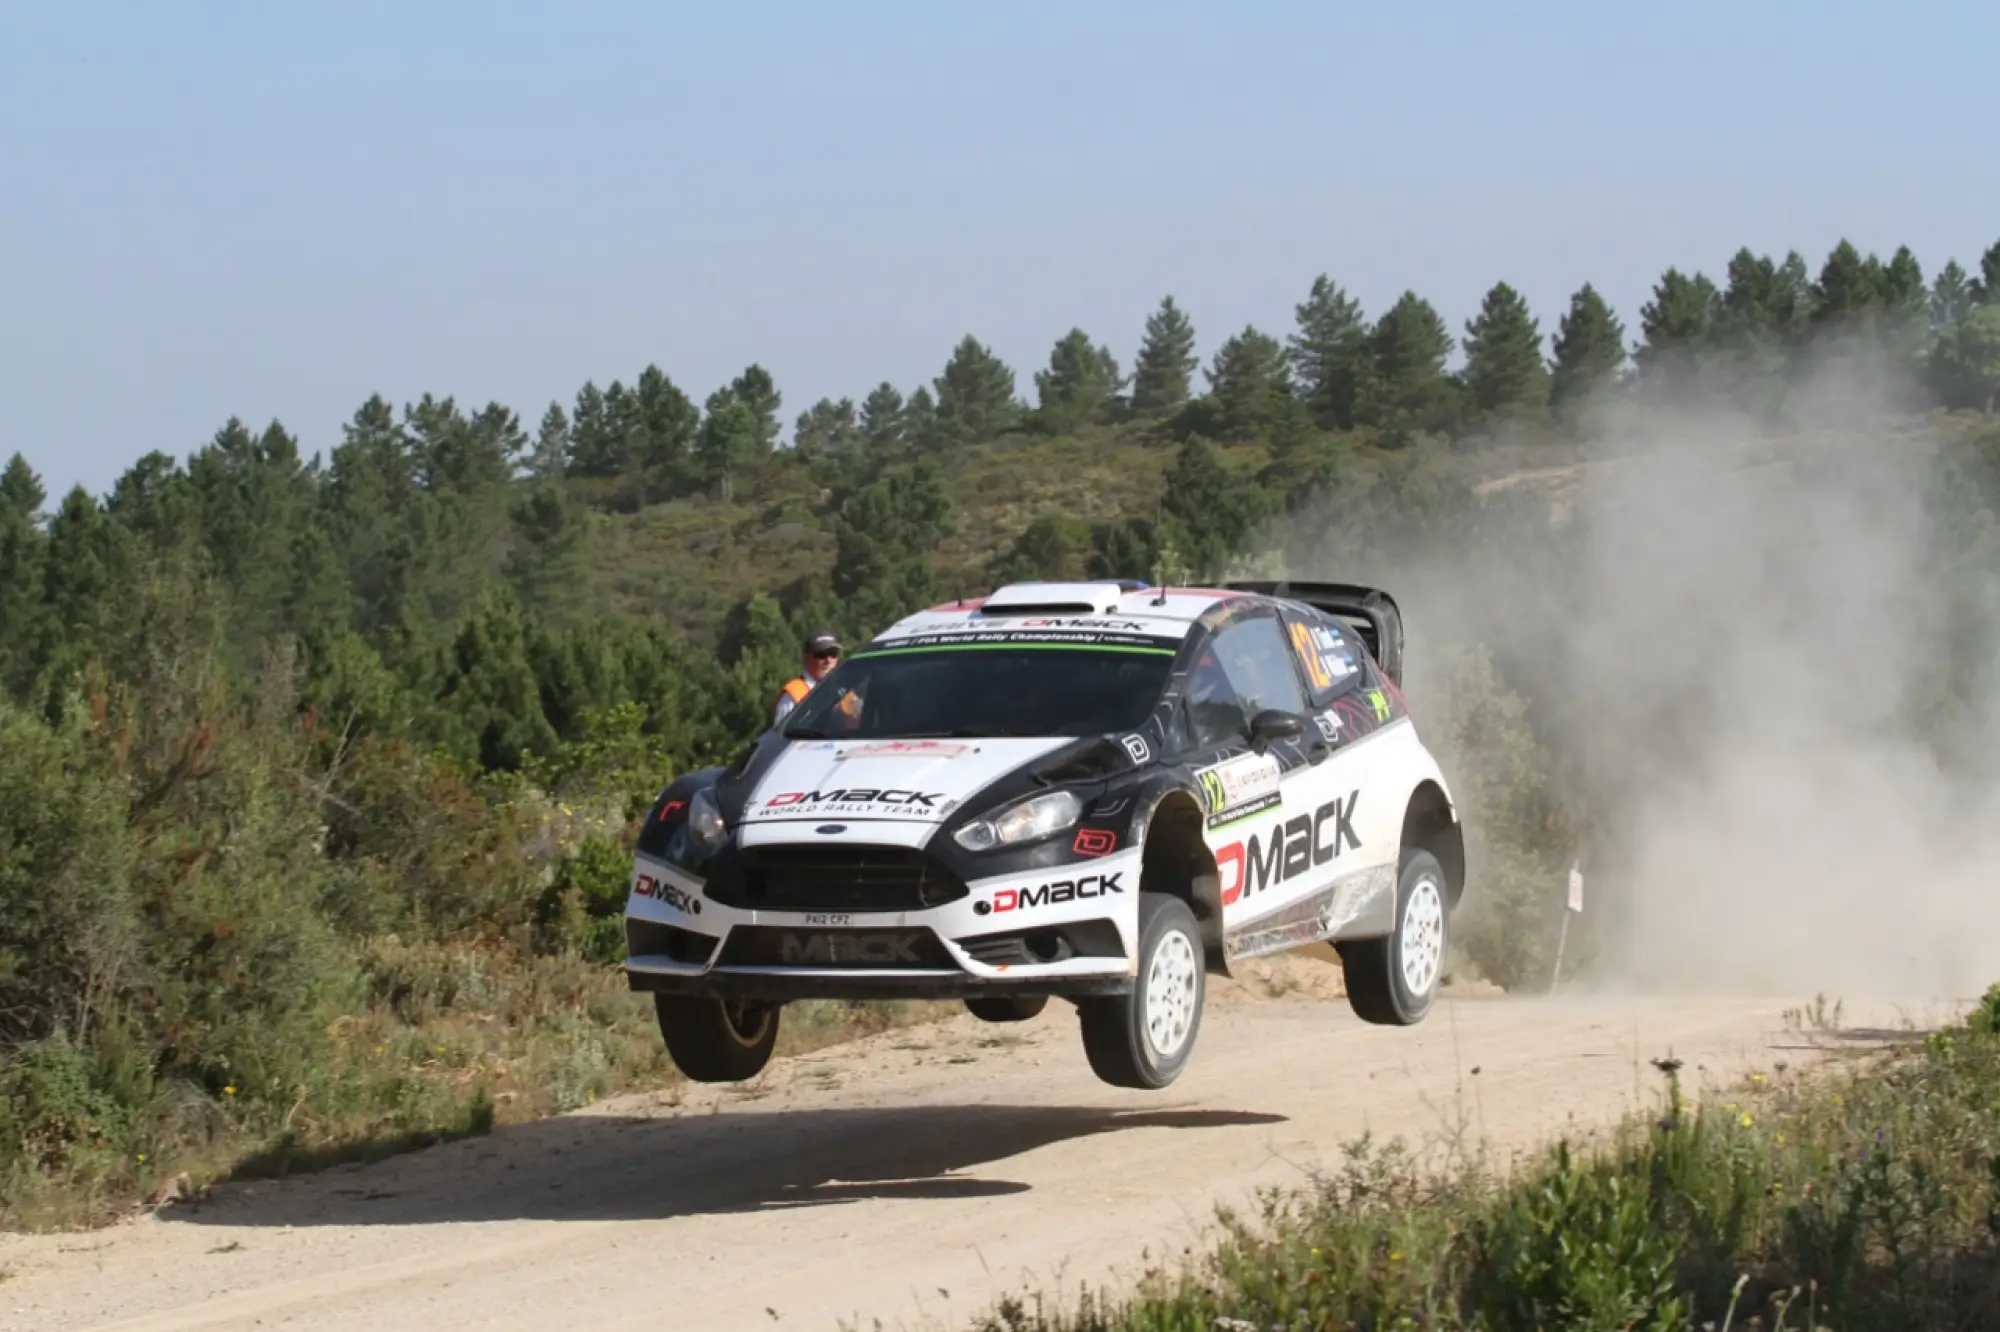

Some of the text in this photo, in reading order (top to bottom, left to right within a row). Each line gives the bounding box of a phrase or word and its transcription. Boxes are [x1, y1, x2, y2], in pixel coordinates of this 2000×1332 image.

[759, 803, 931, 816] WORLD RALLY TEAM
